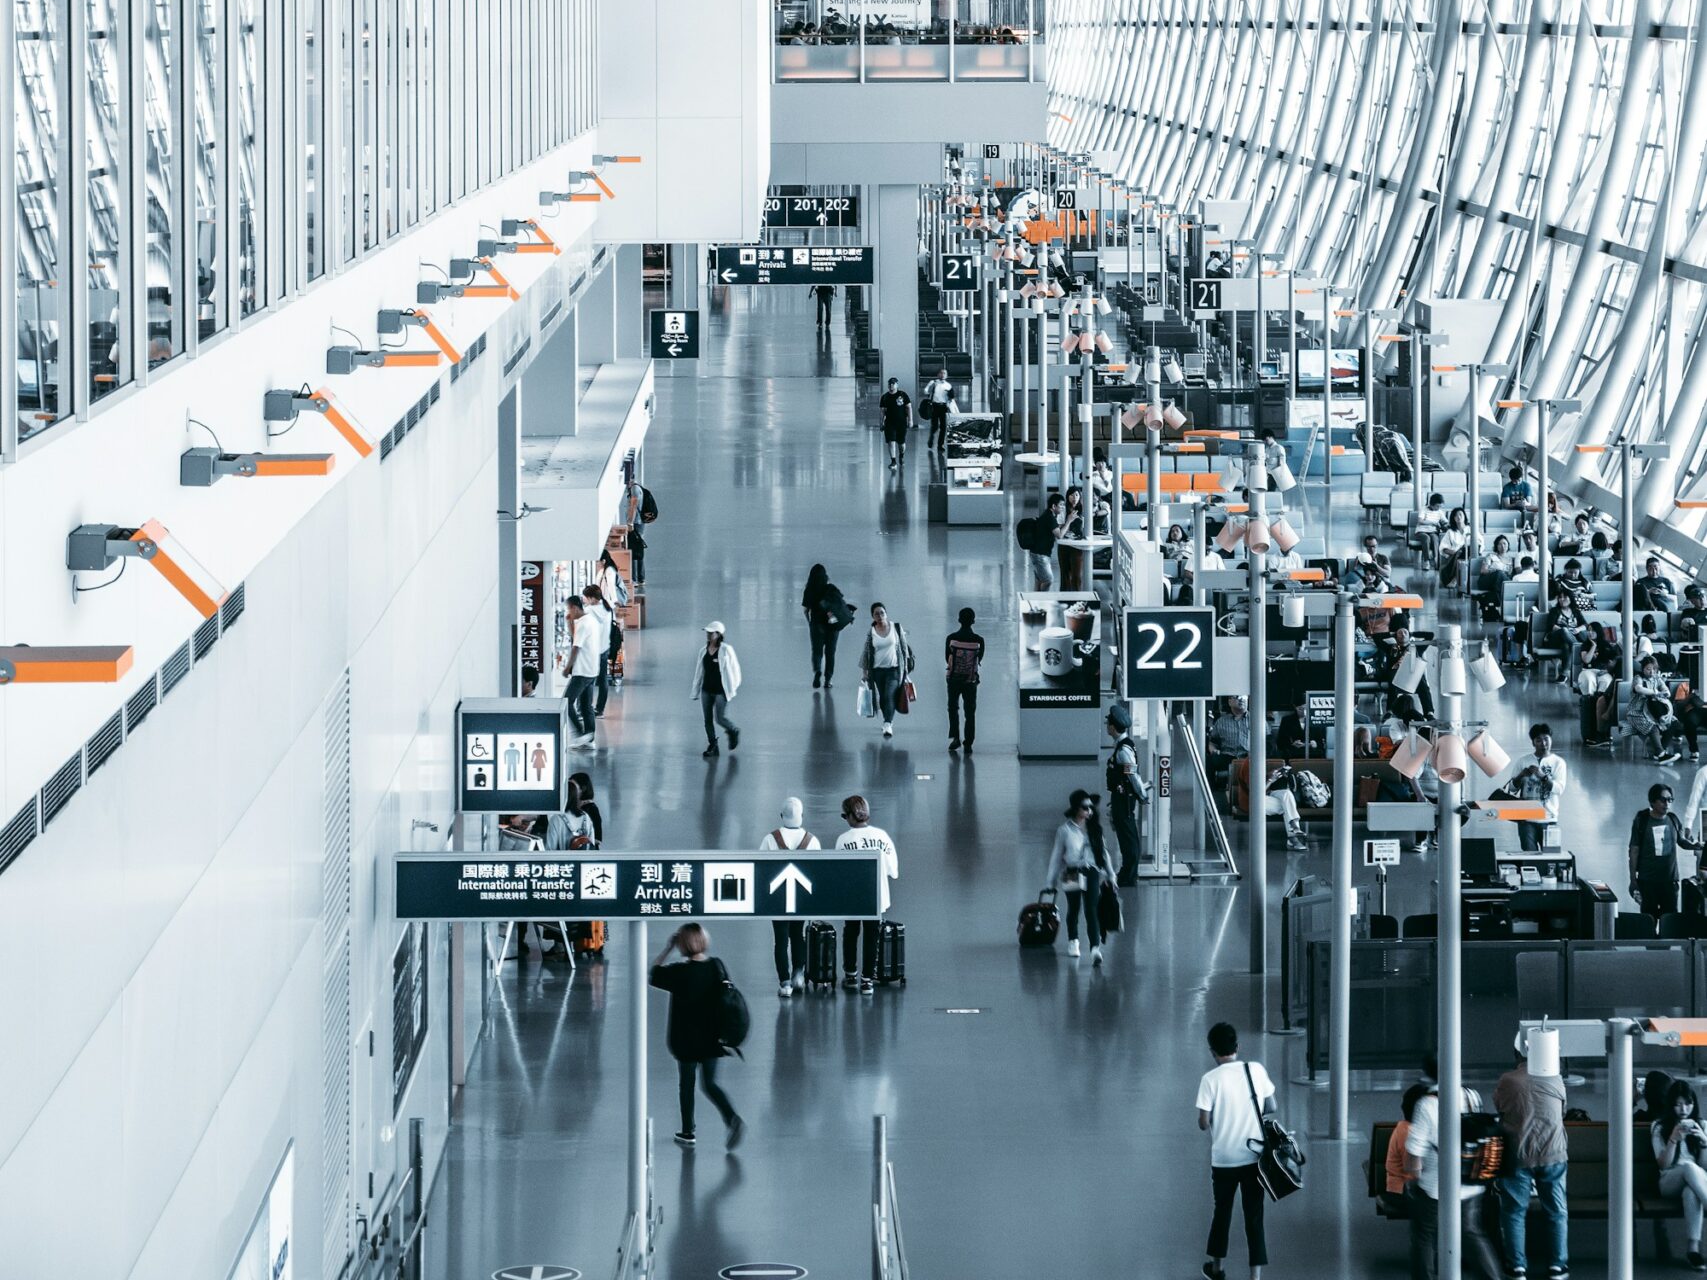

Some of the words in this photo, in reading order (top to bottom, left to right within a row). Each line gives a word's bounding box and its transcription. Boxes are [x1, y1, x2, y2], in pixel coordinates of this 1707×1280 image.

[987, 145, 998, 158] 19
[1059, 192, 1073, 207] 20
[758, 261, 786, 269] Arrivals
[947, 259, 972, 279] 21
[1198, 283, 1216, 307] 21
[1136, 622, 1203, 670] 22
[1161, 770, 1169, 796] AED
[462, 864, 509, 878] 国際線
[514, 864, 575, 878] 乗り継ぎ
[458, 879, 527, 890] International
[531, 879, 575, 890] Transfer
[634, 885, 693, 900] Arrivals
[669, 903, 692, 914] 도착
